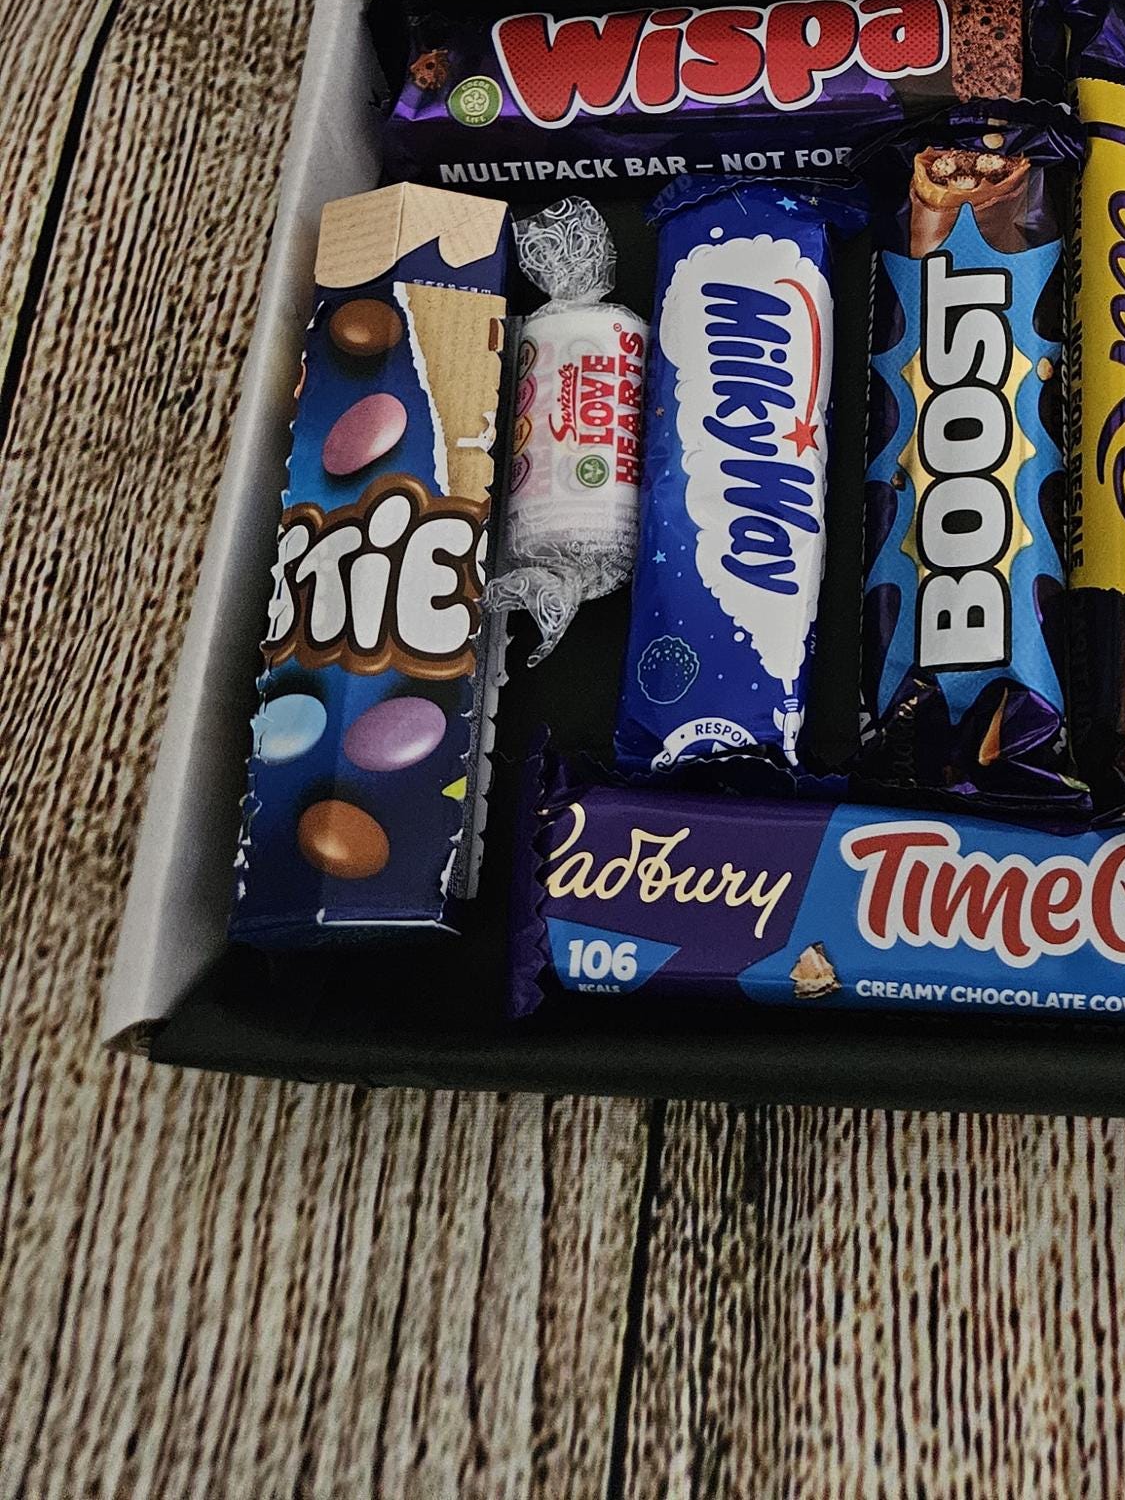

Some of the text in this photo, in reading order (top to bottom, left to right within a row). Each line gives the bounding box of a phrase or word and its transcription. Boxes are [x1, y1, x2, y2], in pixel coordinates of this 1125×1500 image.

[440, 157, 619, 186] MULTIPACK
[622, 155, 688, 181] BAR
[720, 150, 786, 174] NOT
[548, 362, 579, 443] Swizzels
[578, 354, 616, 446] LOVE
[614, 330, 644, 486] HEARTS
[920, 256, 1006, 668] BOOST
[567, 938, 639, 982] 106
[855, 978, 949, 1002] CREAMY
[950, 984, 1087, 1011] CHOCOLATE
